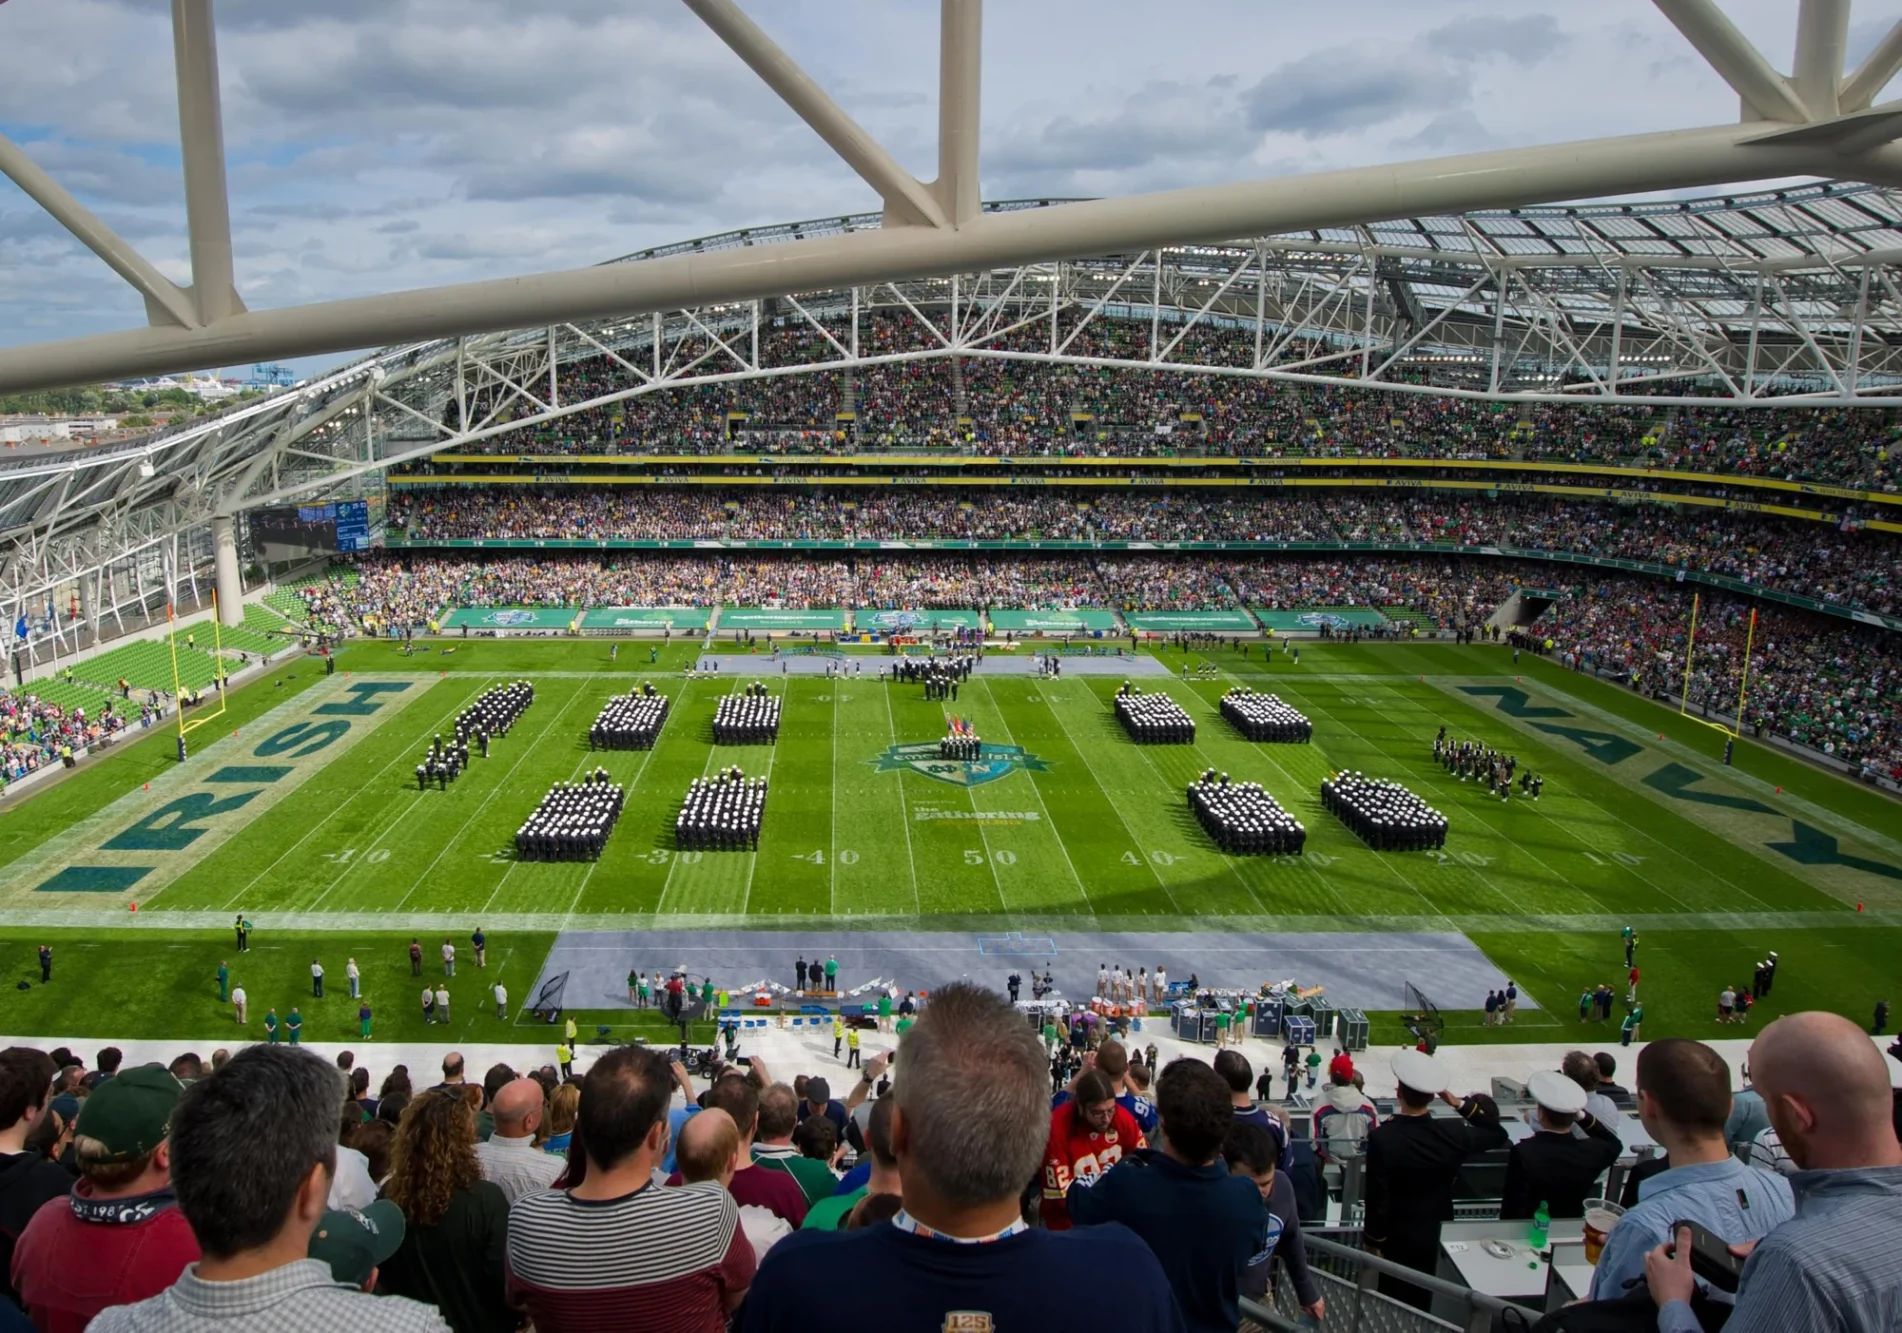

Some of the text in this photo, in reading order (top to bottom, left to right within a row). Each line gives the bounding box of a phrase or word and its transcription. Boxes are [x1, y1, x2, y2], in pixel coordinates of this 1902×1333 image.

[1503, 483, 1535, 491] AVIVA
[1619, 490, 1651, 499] AVIVA
[1734, 500, 1762, 512] AVIVA
[33, 682, 415, 892] IRISH
[1455, 686, 1902, 880] NAVY
[915, 811, 1040, 821] gathering
[963, 849, 1017, 865] 50
[1046, 1165, 1070, 1188] 82
[951, 1315, 987, 1329] 125
